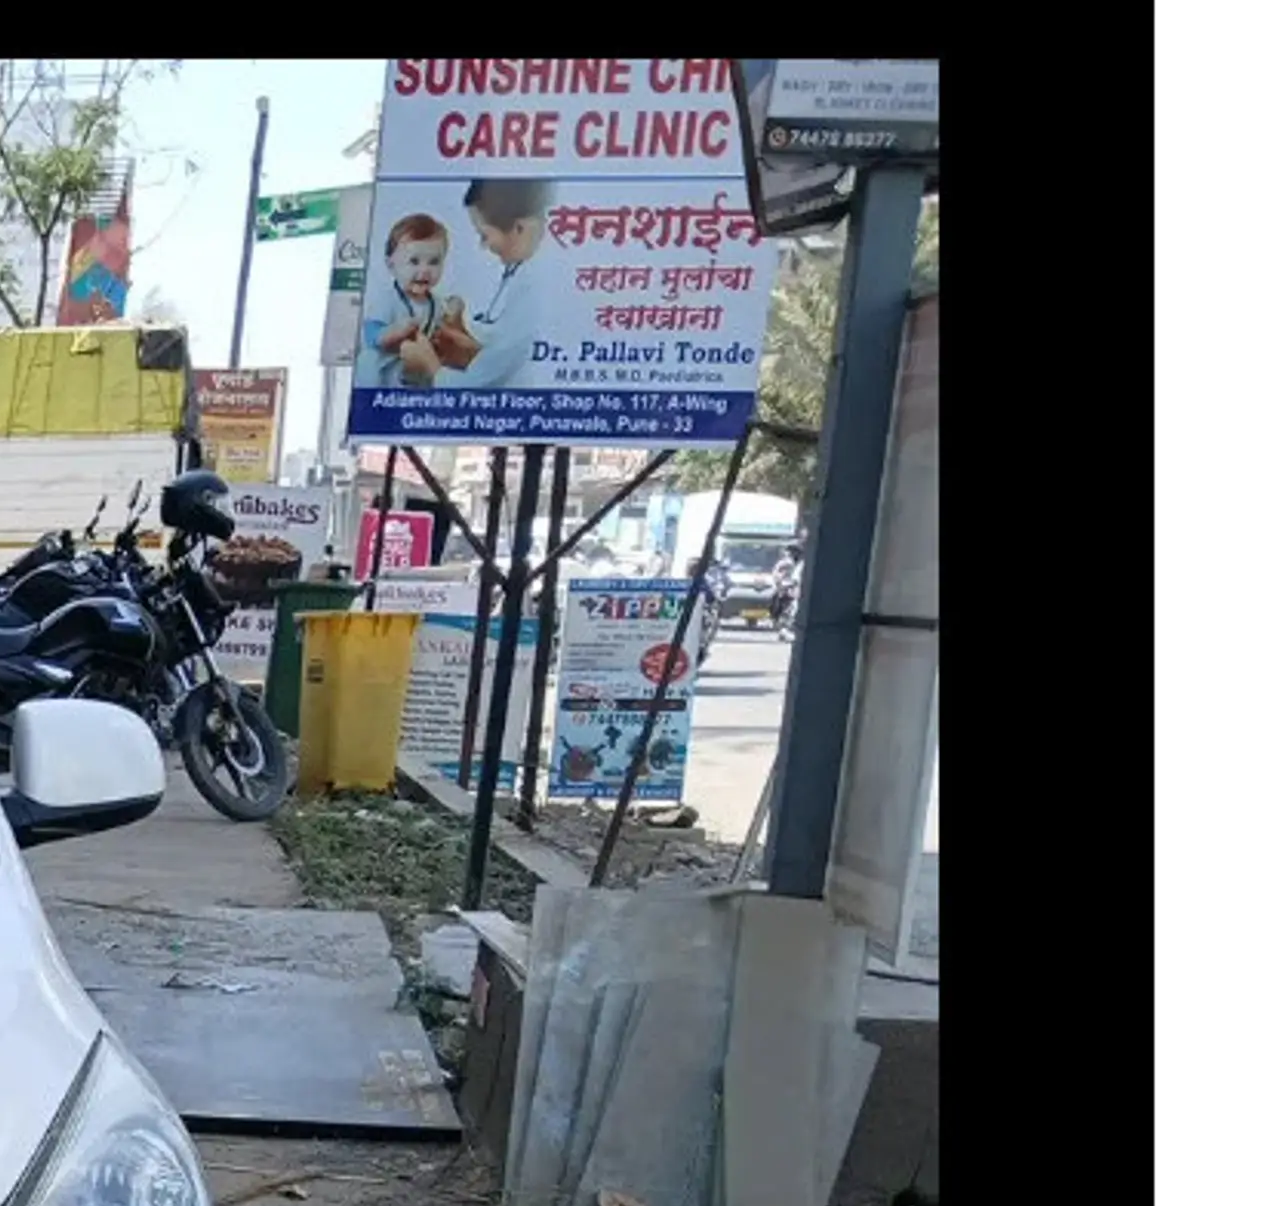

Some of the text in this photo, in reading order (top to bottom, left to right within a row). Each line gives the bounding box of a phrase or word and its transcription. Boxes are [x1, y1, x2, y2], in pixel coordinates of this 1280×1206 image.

[393, 58, 734, 96] SUNSHINE CHI
[436, 110, 731, 158] CARE CLINIC
[547, 191, 763, 254] सनशाईन
[574, 259, 755, 301] लहान मुलांचा
[595, 304, 725, 332] दवाखाना
[532, 340, 756, 365] Dr. Pallavi Tonde
[616, 416, 659, 432] Pune
